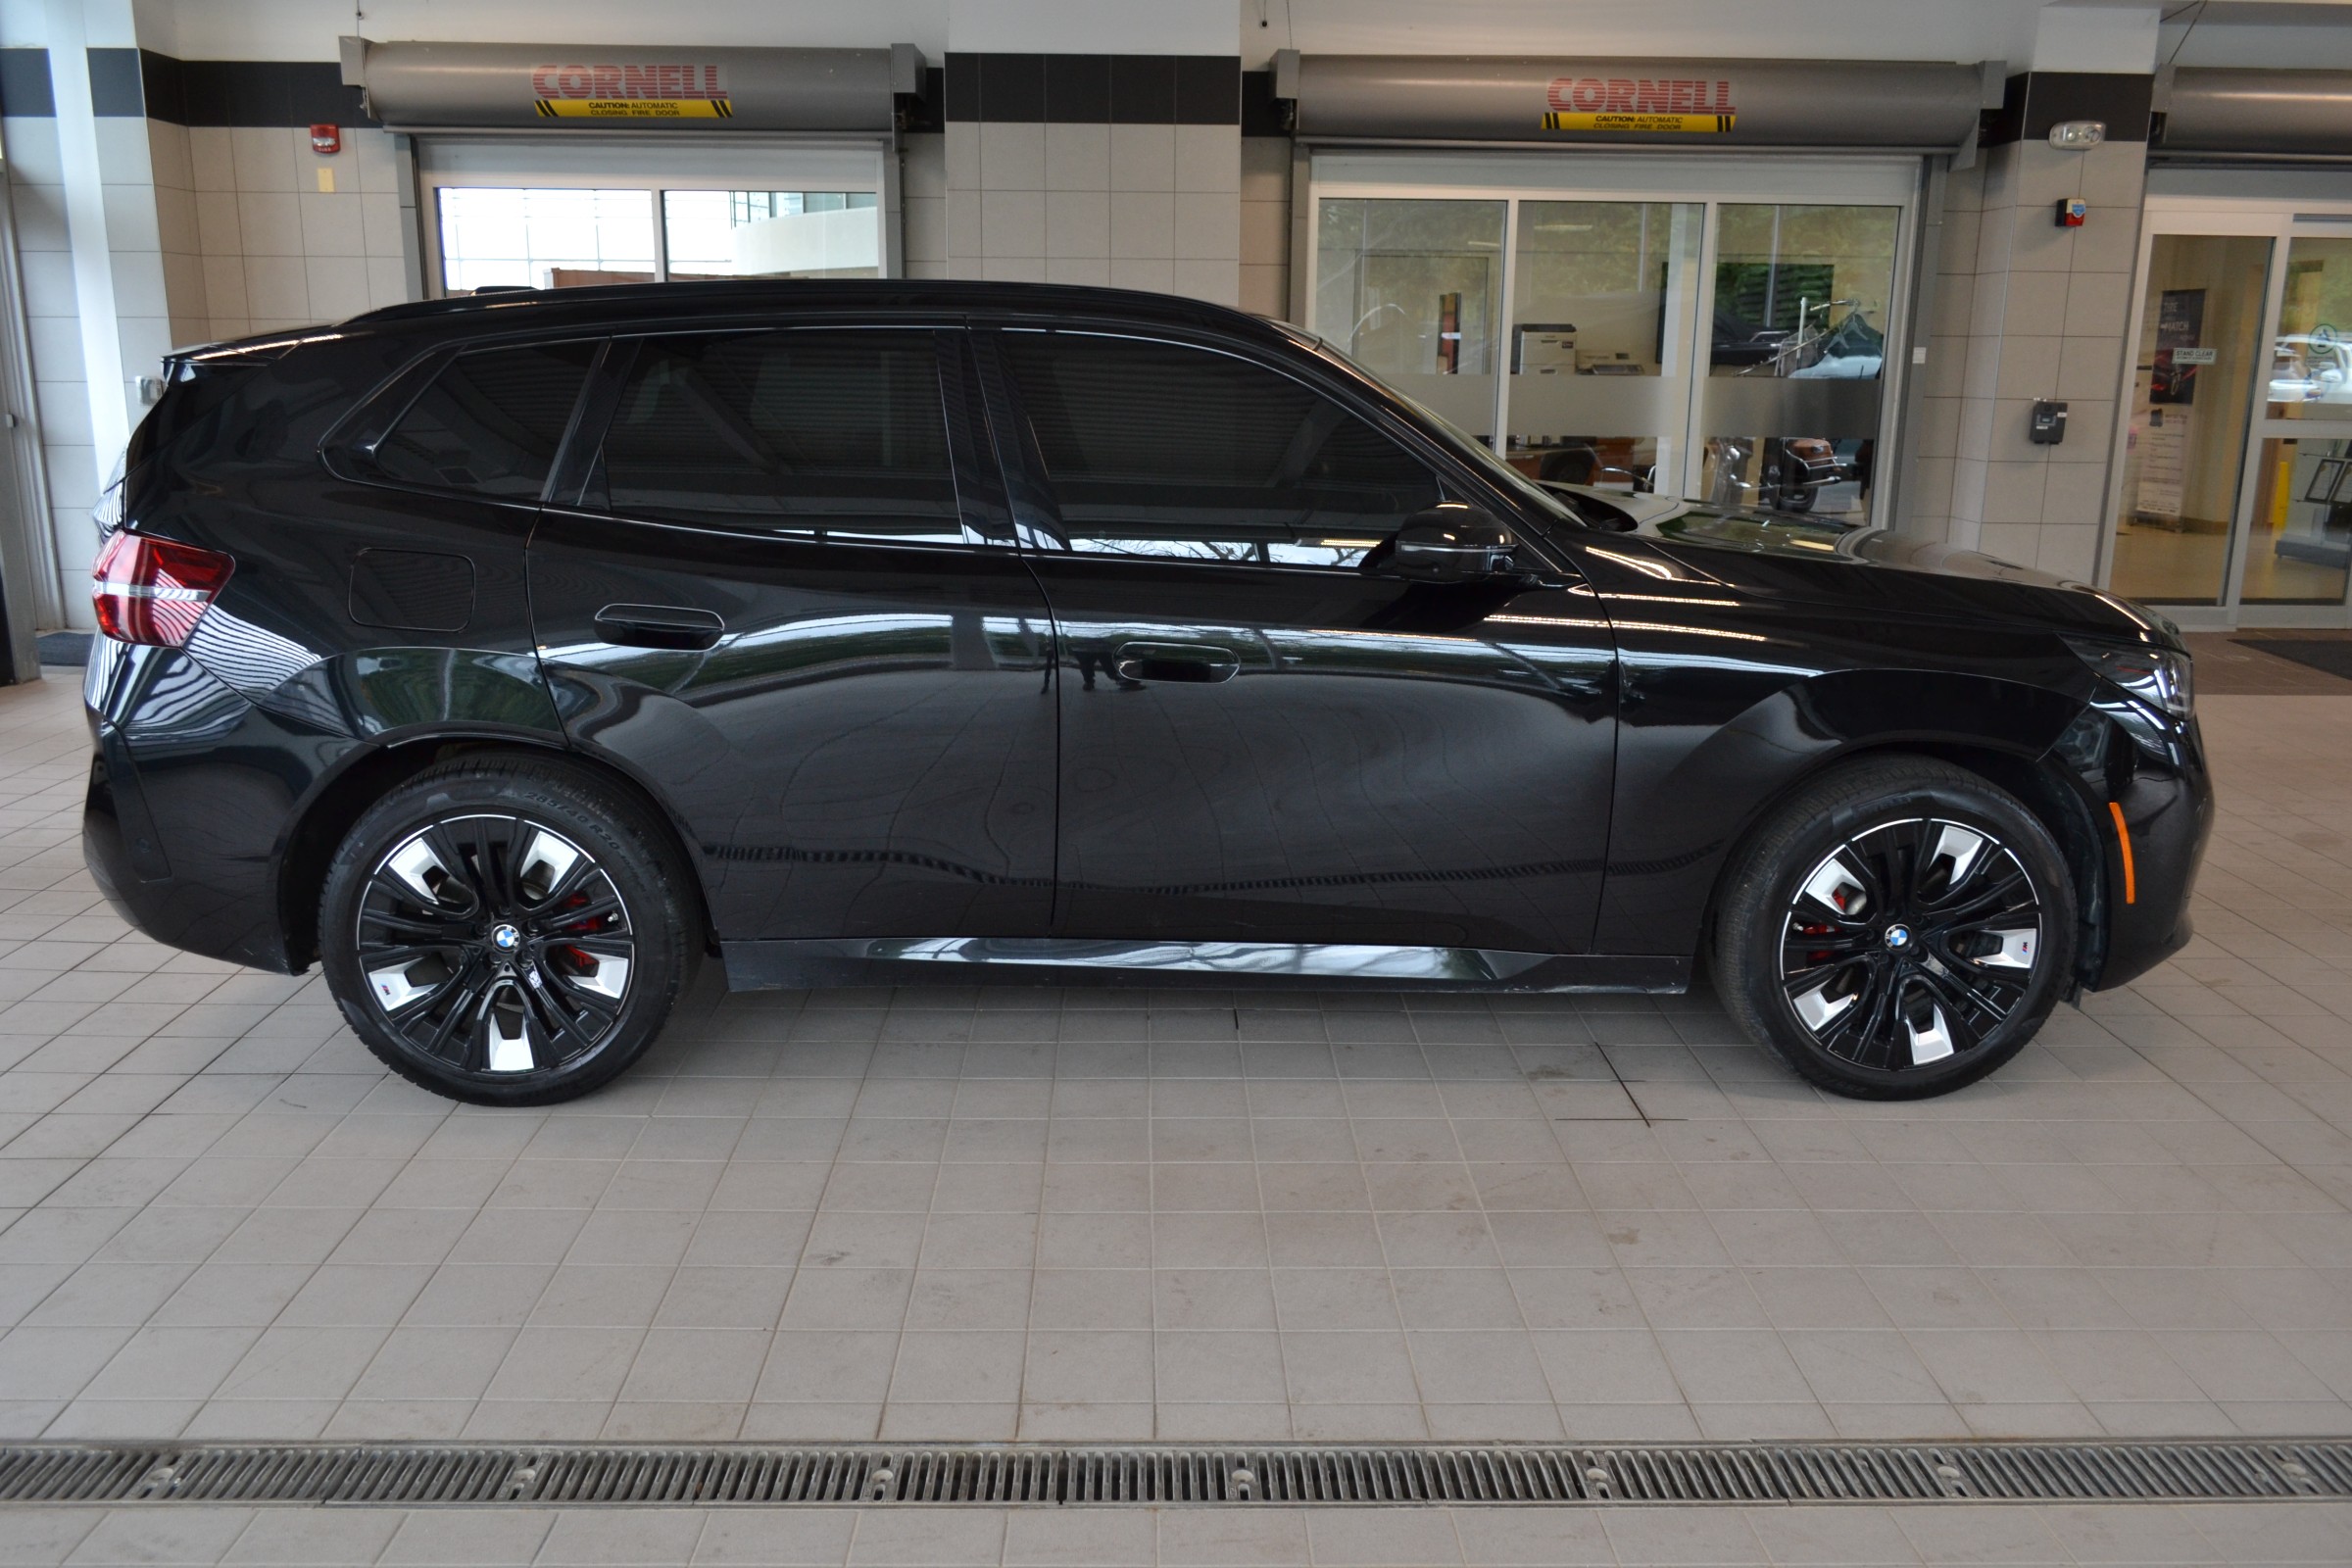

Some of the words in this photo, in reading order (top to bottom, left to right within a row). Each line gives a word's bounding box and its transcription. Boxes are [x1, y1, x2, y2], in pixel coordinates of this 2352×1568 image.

[532, 65, 728, 99] CORNELL
[1547, 77, 1737, 115] CORNELL
[589, 824, 620, 850] R20
